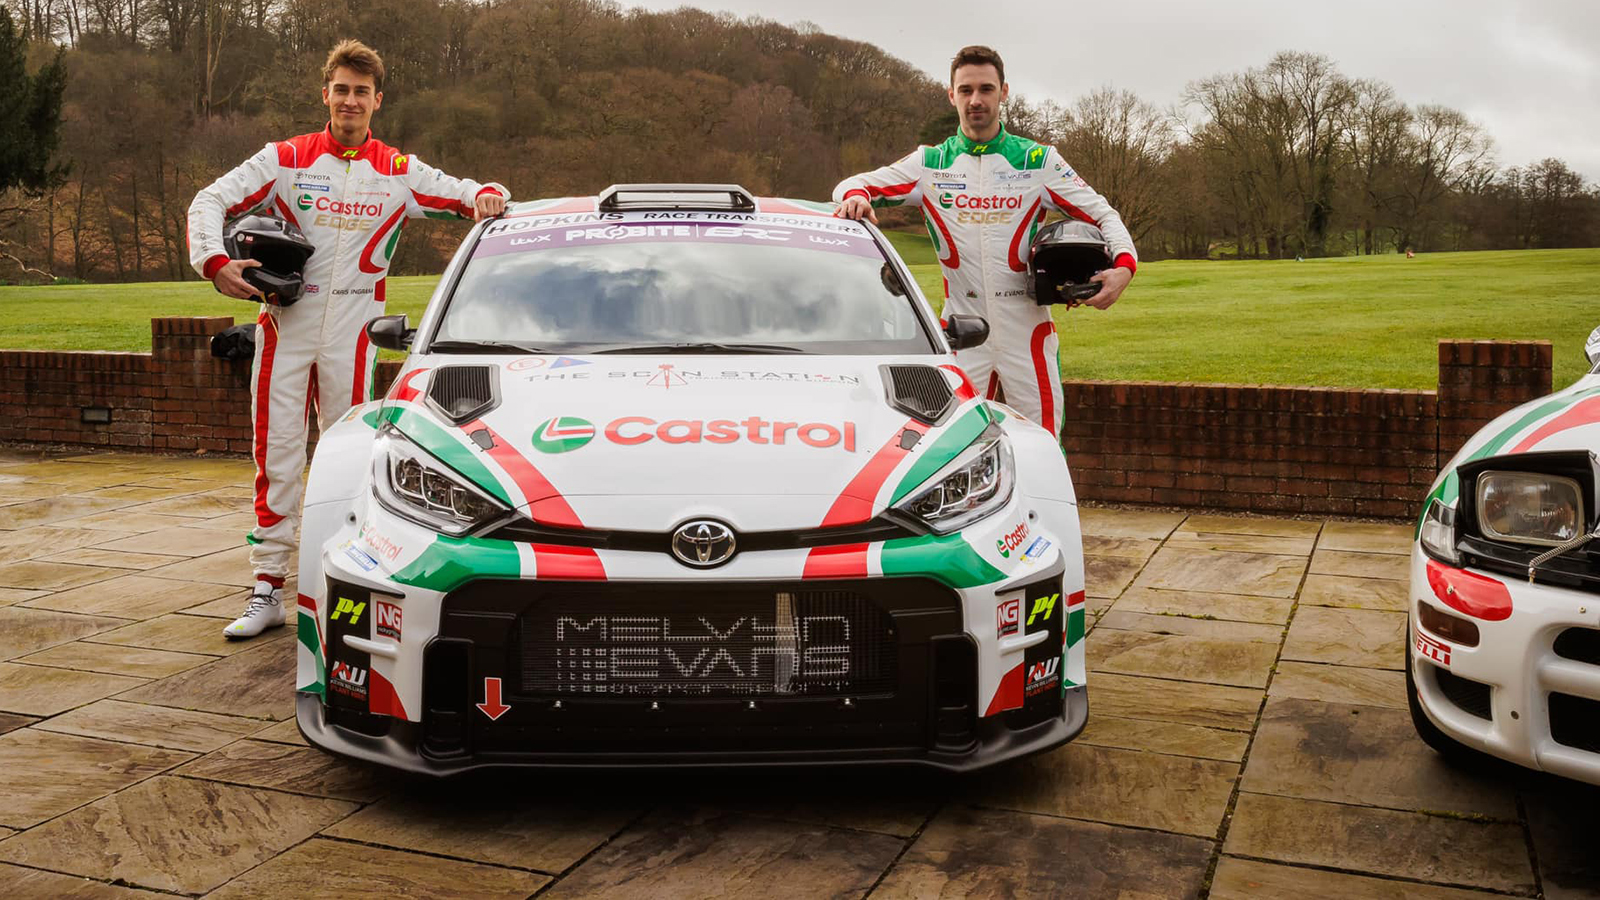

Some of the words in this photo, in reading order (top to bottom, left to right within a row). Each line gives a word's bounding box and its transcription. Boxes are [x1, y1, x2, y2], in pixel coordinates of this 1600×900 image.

[304, 173, 331, 181] TOYOTA
[315, 196, 383, 217] Castrol
[955, 194, 1023, 209] Castrol
[313, 214, 375, 232] EDGE
[488, 212, 624, 235] HOPKINS
[704, 213, 865, 235] TRANSPORTERS
[956, 211, 1015, 225] EDGE
[1004, 289, 1025, 297] EVANS
[524, 372, 591, 382] THE
[604, 416, 856, 453] Castrol
[365, 526, 403, 561] Castrol
[330, 597, 366, 625] P1
[378, 603, 401, 630] NG
[998, 601, 1018, 628] NG
[1026, 593, 1060, 626] P1
[1416, 638, 1451, 666] ELLI
